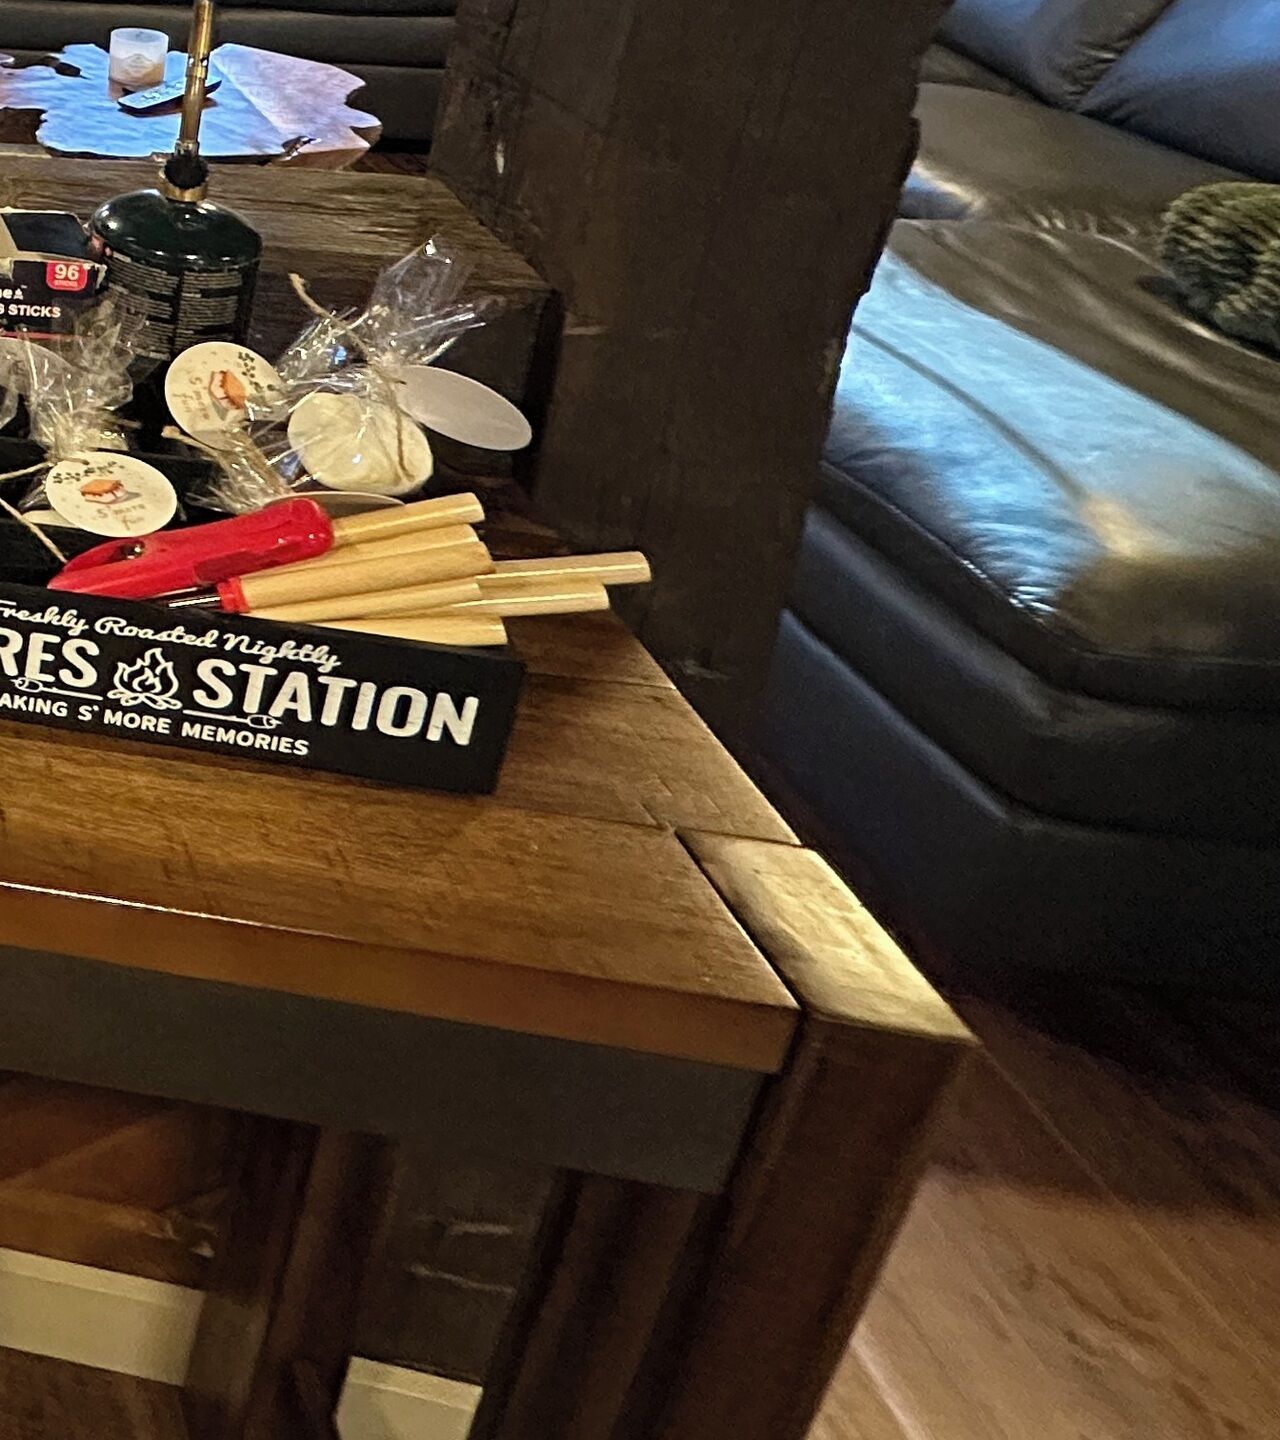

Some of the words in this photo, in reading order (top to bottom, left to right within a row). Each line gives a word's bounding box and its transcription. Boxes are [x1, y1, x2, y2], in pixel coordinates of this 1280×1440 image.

[54, 263, 80, 281] 96
[8, 303, 61, 318] STICKS
[95, 617, 218, 649] Roasted
[223, 632, 341, 673] Nightly
[192, 658, 479, 746] STATION
[181, 720, 310, 756] MEMORIES
